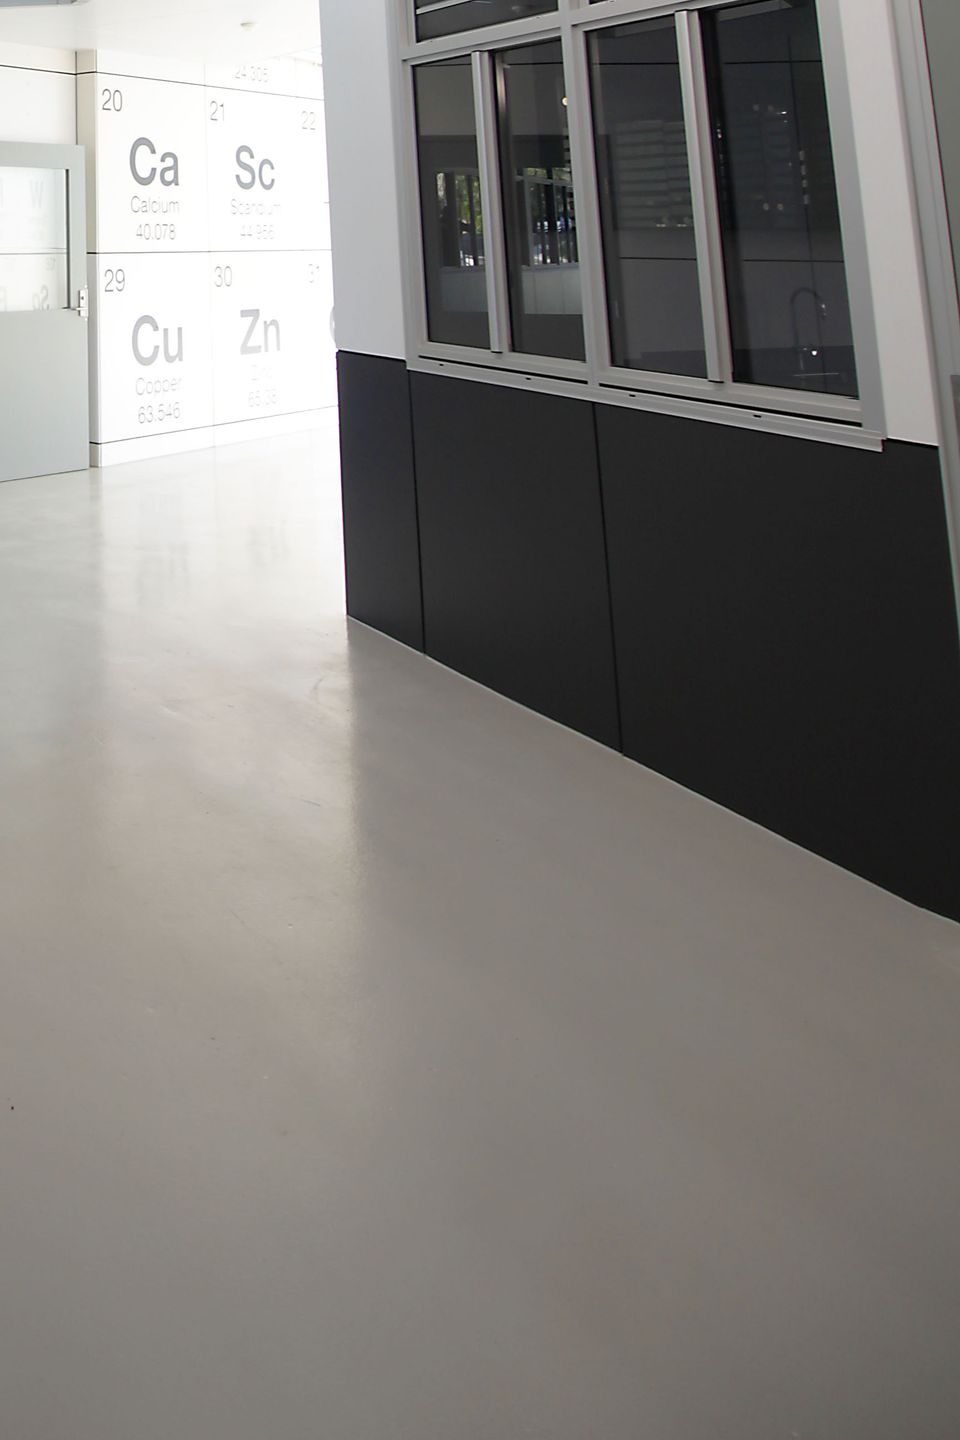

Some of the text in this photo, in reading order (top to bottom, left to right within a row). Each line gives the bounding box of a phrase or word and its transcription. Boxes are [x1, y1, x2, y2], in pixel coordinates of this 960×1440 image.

[101, 88, 123, 112] 20
[208, 100, 225, 122] 21
[300, 111, 317, 131] 22
[129, 136, 180, 187] Ca
[234, 144, 276, 191] Sc
[130, 195, 181, 214] Calcium
[135, 222, 176, 241] 40.078
[103, 268, 126, 293] 29
[213, 265, 233, 288] 30
[131, 314, 184, 366] Cu
[239, 308, 281, 355] Zn
[135, 376, 182, 399] Copper
[137, 401, 181, 424] 63.546
